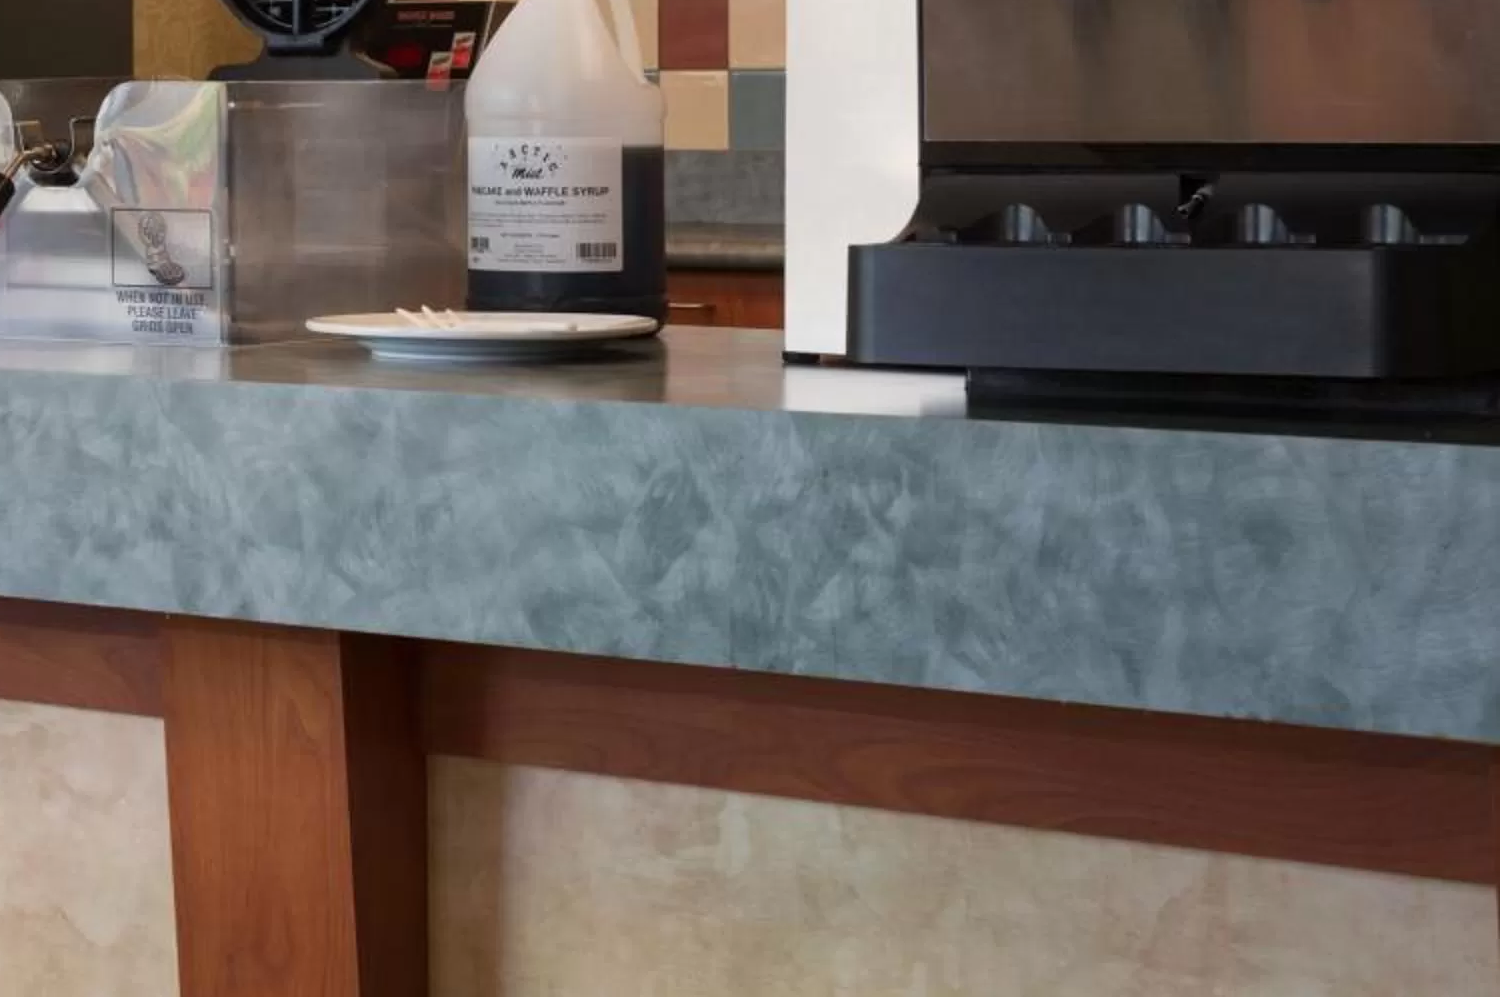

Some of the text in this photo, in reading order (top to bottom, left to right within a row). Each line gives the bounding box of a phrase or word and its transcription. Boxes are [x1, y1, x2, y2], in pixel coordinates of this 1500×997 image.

[524, 186, 569, 196] WAFFLE
[572, 186, 610, 196] SYRUP
[115, 290, 146, 304] WHEN
[148, 292, 168, 304] NOT
[127, 305, 164, 318] PLEASE
